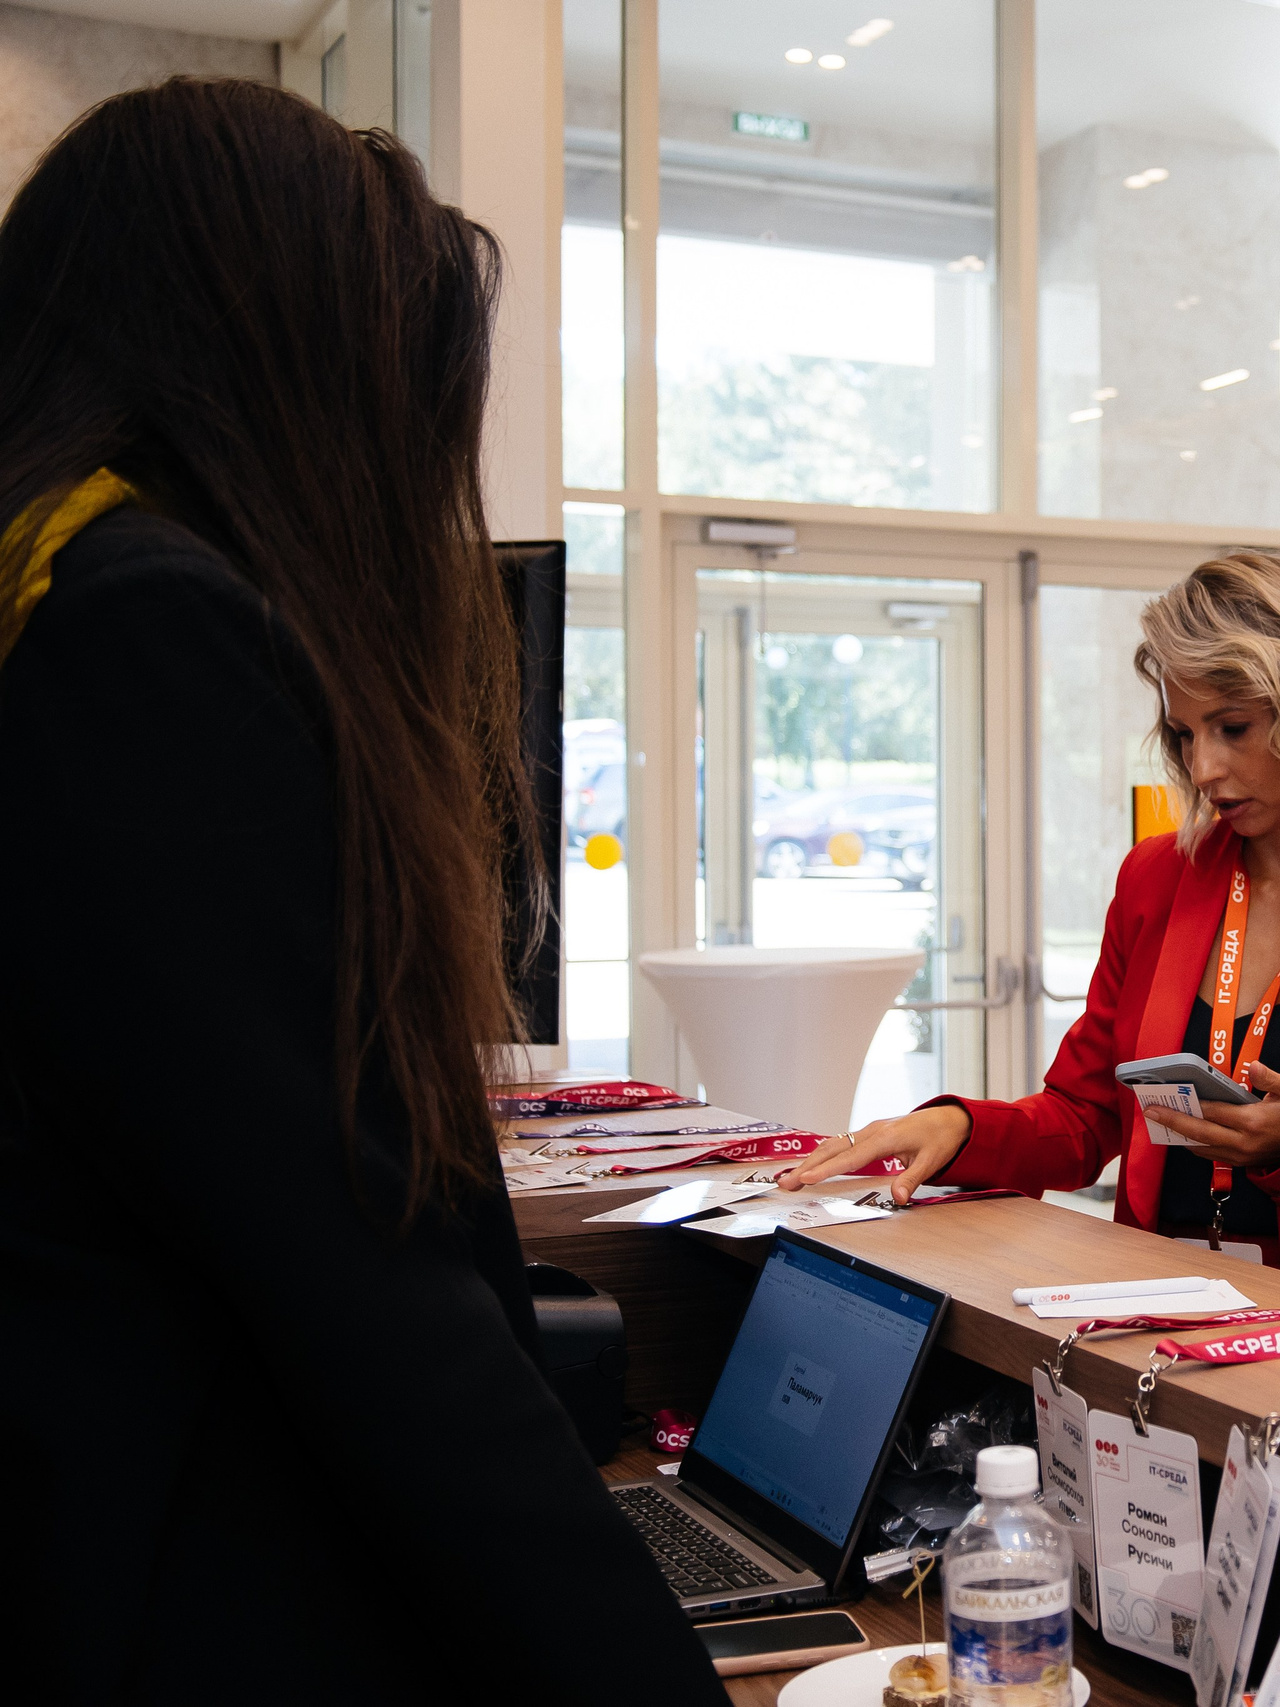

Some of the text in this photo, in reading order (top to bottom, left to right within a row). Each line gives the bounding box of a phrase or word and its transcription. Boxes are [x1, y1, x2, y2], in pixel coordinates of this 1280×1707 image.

[1232, 870, 1246, 903] OCS
[1218, 929, 1239, 1003] IT-СРЕДА
[1252, 1002, 1271, 1036] OCS
[1212, 1029, 1227, 1065] OCS
[580, 1095, 639, 1106] IT-СРЕДА
[622, 1087, 649, 1097] OCS
[518, 1101, 546, 1112] OCS
[773, 1139, 802, 1152] OCS
[787, 1377, 824, 1406] Паламарчук
[656, 1430, 690, 1447] OCS
[1052, 1452, 1077, 1483] Виталий
[1149, 1465, 1188, 1485] IT-СРЕДА
[1047, 1466, 1084, 1506] Скоморохов
[1127, 1501, 1167, 1528] Роман
[1121, 1519, 1176, 1549] Соколов
[1127, 1545, 1174, 1572] Русичи
